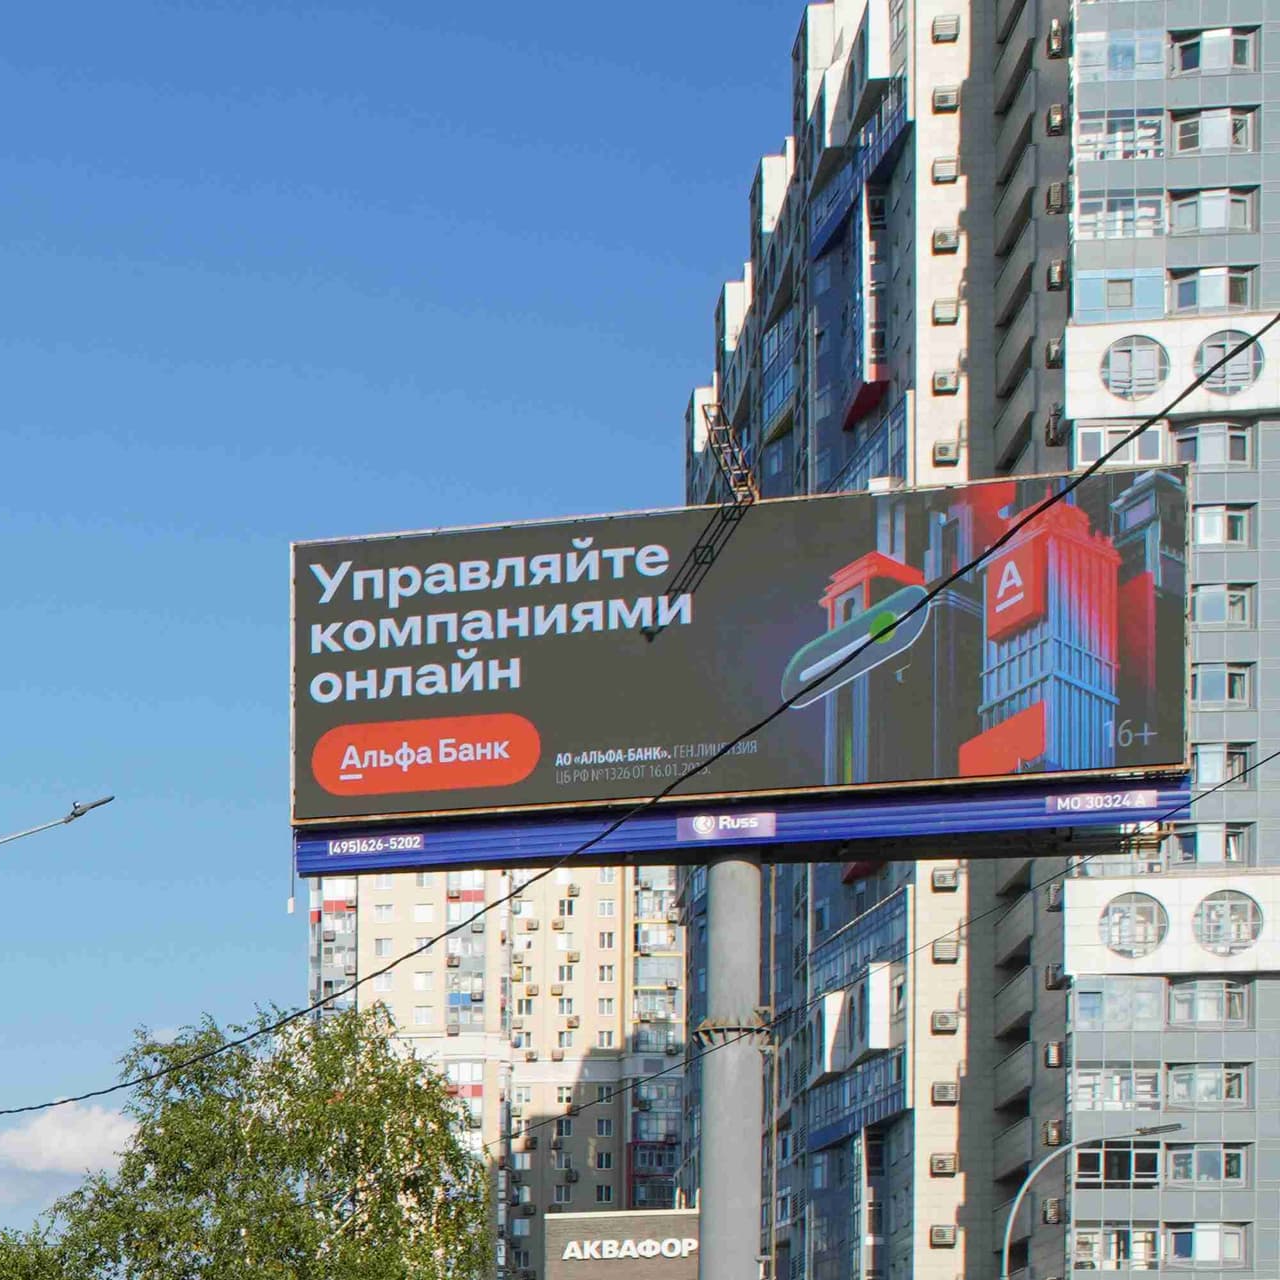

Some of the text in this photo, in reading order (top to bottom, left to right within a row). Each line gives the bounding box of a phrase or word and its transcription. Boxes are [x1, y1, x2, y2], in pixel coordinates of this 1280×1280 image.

[309, 537, 670, 608] Управляйте
[310, 592, 692, 654] компаниями
[309, 648, 521, 703] онлайн
[1103, 719, 1158, 748] 16+
[340, 738, 510, 780] Альфа Банк
[555, 752, 572, 767] АО
[1057, 797, 1081, 810] МО
[1085, 794, 1131, 809] 30324
[719, 815, 759, 830] Russ
[328, 836, 421, 856] (495)626-5202
[562, 1237, 698, 1261] АКВАФОР
